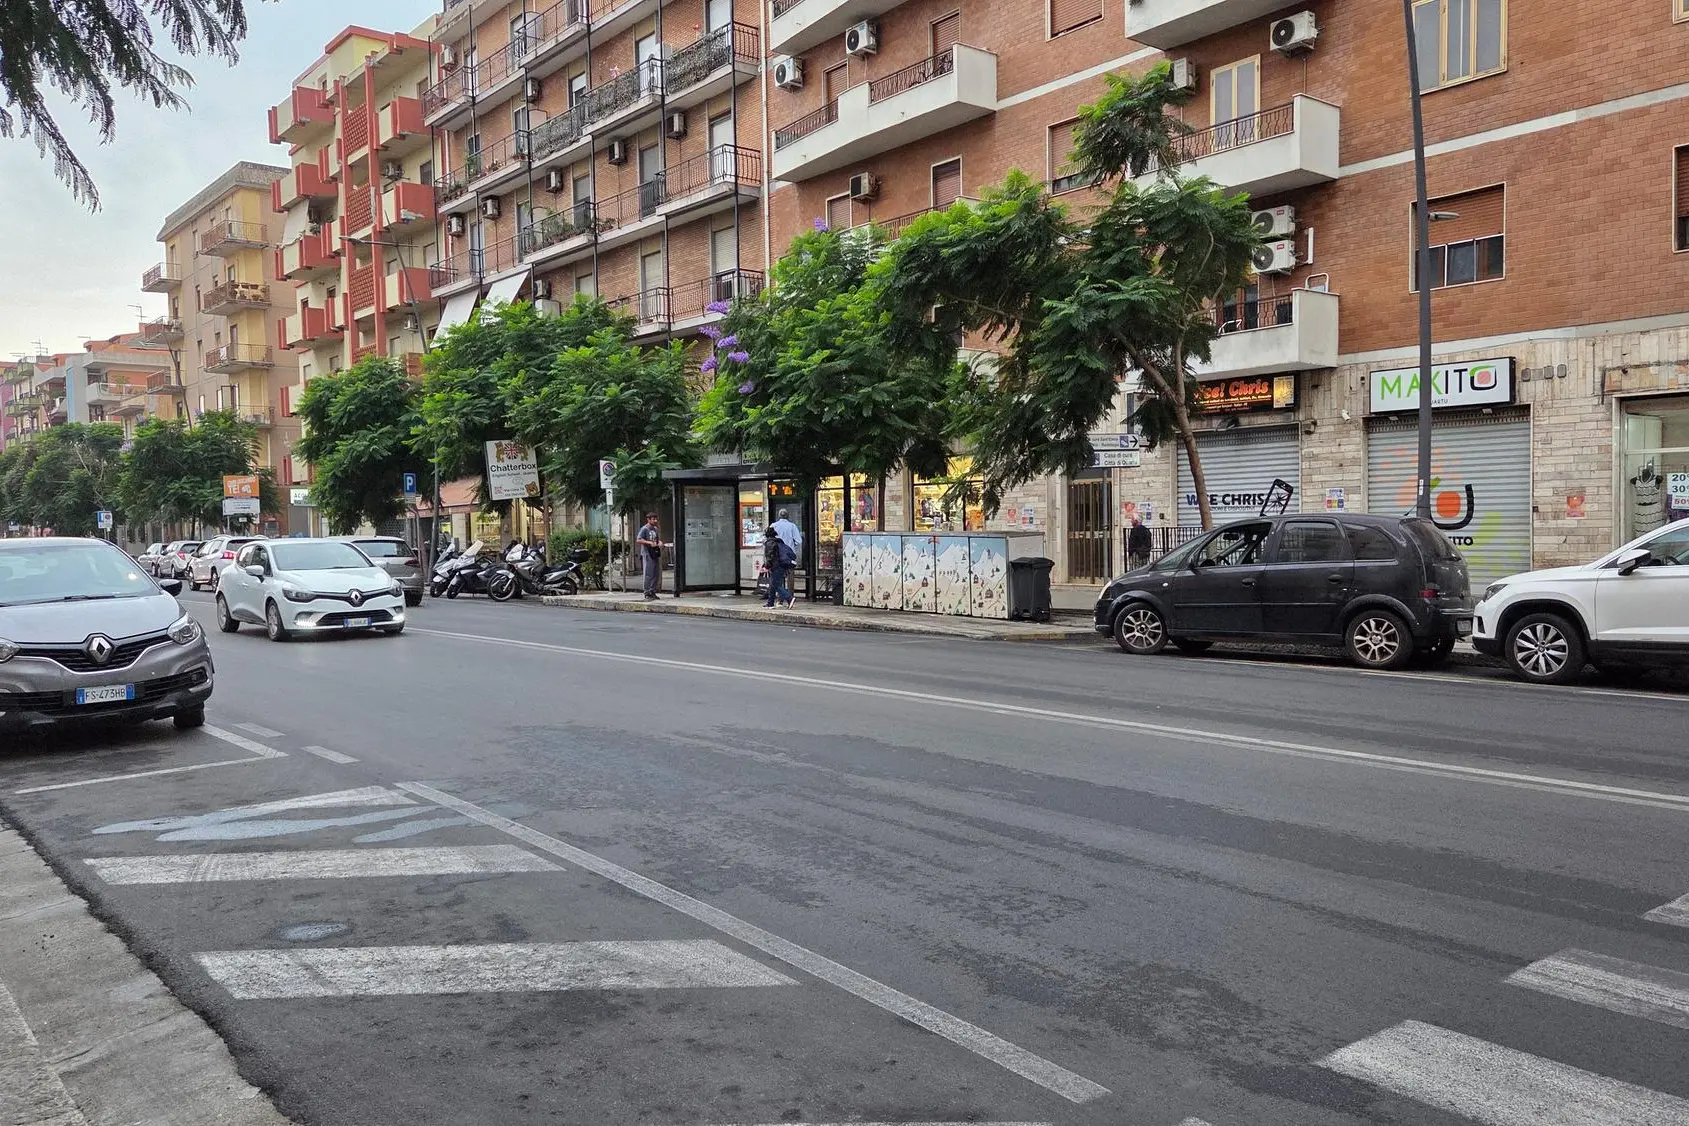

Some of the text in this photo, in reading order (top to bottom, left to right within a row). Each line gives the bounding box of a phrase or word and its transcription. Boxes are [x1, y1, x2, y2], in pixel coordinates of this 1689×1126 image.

[1229, 379, 1269, 397] Chris
[490, 463, 537, 472] Chatterbox
[406, 475, 414, 490] P
[1222, 493, 1265, 506] CHRIS
